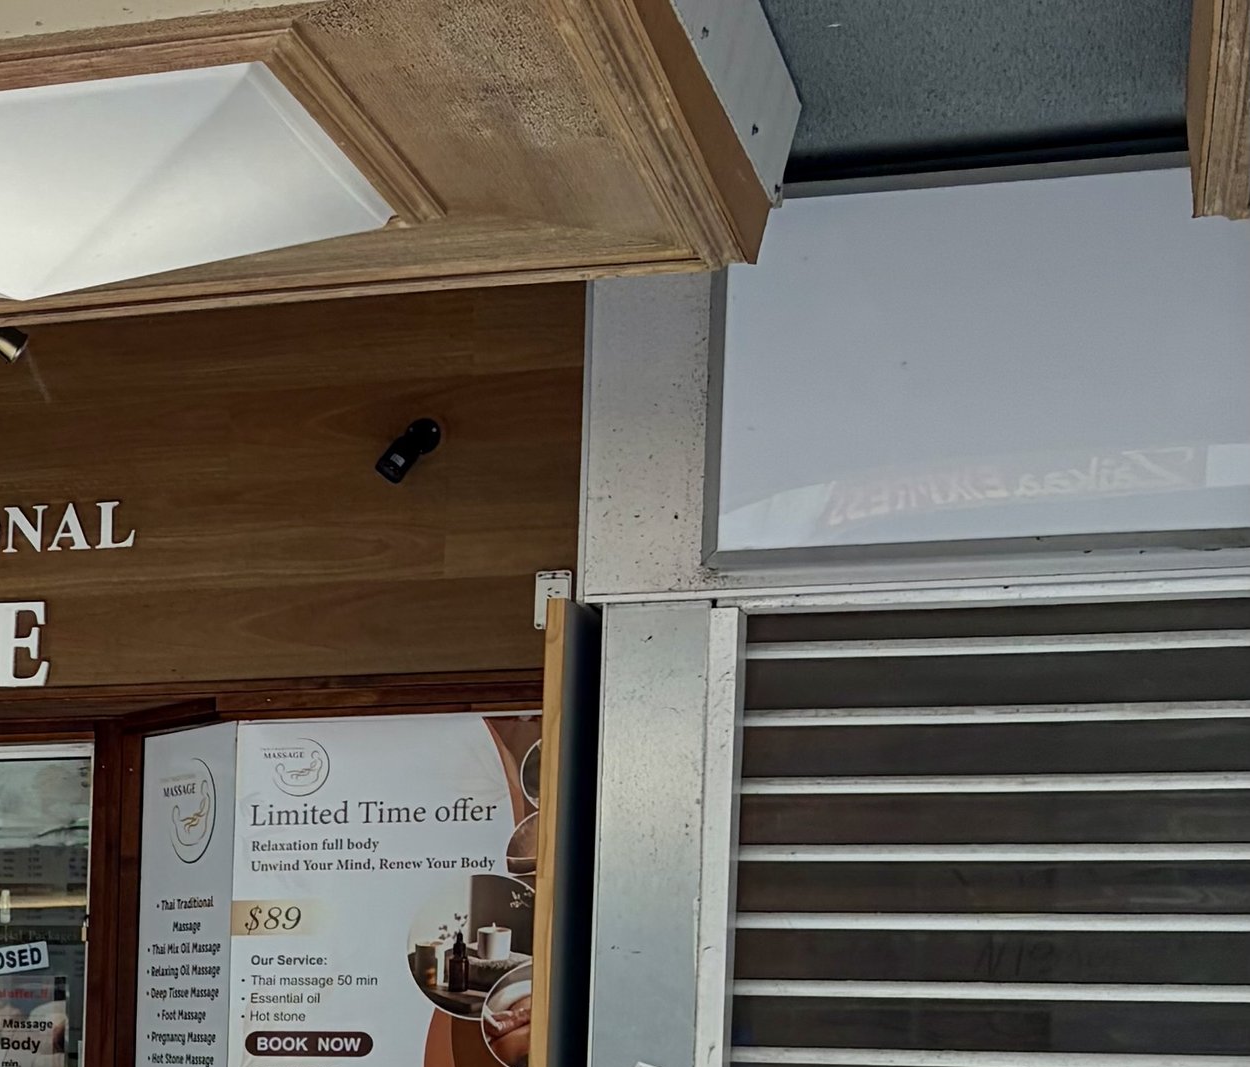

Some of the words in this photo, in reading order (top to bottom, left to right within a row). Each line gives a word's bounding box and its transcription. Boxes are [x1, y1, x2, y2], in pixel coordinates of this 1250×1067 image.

[264, 751, 305, 759] MASSAGE
[163, 783, 196, 797] MASSAGE
[250, 800, 349, 826] Limited
[358, 801, 426, 824] Time
[434, 797, 498, 822] offer
[251, 839, 318, 852] Relaxation
[321, 839, 343, 851] full
[347, 838, 380, 852] body
[251, 859, 300, 872] Unwind
[303, 859, 333, 872] Your
[336, 858, 375, 873] Mind,
[379, 858, 422, 871] Renew
[425, 857, 457, 870] Your
[460, 857, 496, 872] Body
[161, 899, 176, 911] Thai
[177, 896, 214, 910] Traditional
[244, 905, 302, 935] $89
[172, 921, 201, 934] Massage
[152, 944, 166, 955] Thai
[167, 944, 179, 954] Mix
[180, 943, 191, 954] Oil
[191, 942, 221, 956] Massage
[251, 954, 274, 966] Our
[277, 954, 328, 966] Service:
[151, 966, 179, 979] Relaxing
[180, 965, 190, 976] Oil
[191, 964, 221, 978] Massage
[251, 974, 276, 986] Thai
[279, 976, 334, 988] massage
[337, 974, 353, 986] 50
[356, 974, 379, 986] min
[151, 987, 168, 1001] Deep
[169, 987, 189, 999] Tissue
[190, 987, 219, 1001] Massage
[250, 992, 303, 1004] Essential
[307, 992, 321, 1004] oil
[161, 1009, 176, 1021] Foot
[178, 1009, 206, 1023] Massage
[249, 1009, 270, 1022] Hot
[273, 1010, 306, 1022] stone
[2, 1017, 54, 1031] Massage
[0, 1036, 40, 1054] Body
[151, 1031, 186, 1046] Pregnancy
[187, 1032, 216, 1046] Massage
[256, 1036, 308, 1052] BOOK
[317, 1037, 362, 1052] NOW
[151, 1053, 164, 1064] Hot
[165, 1053, 183, 1065] Stone
[185, 1054, 214, 1067] Massage
